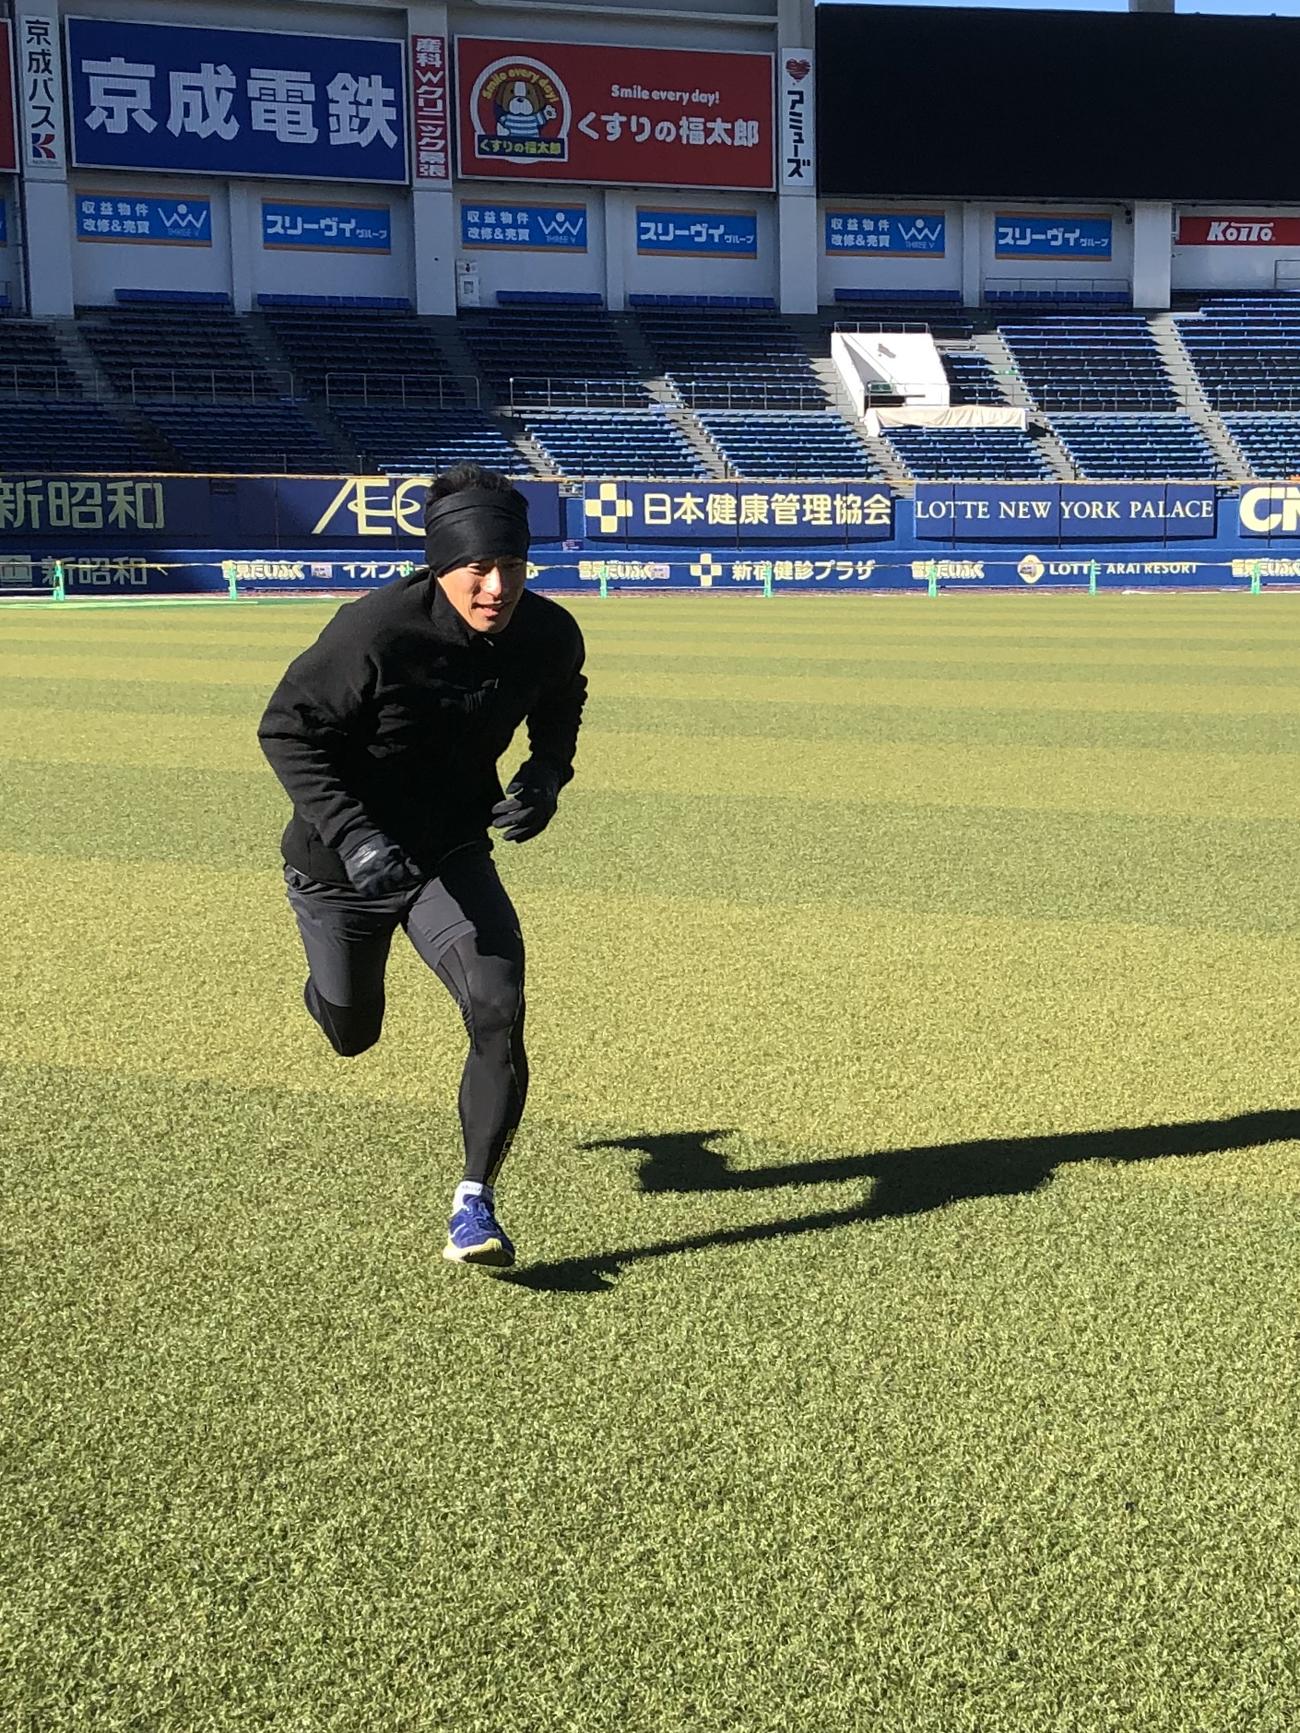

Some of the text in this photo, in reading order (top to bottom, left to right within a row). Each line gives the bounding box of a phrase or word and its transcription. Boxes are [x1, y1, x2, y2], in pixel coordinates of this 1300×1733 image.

[25, 19, 55, 129] 京成バス
[81, 57, 399, 150] 京成電鉄
[611, 84, 720, 107] Smile every day!
[577, 111, 760, 148] くすりの福太郎
[787, 89, 811, 178] アミューズ
[480, 138, 561, 155] くすりの福太郎
[81, 200, 149, 217] 収益物件
[467, 210, 528, 225] 収益物件
[831, 217, 890, 231] 収益物件
[0, 478, 165, 529] 新昭和
[644, 492, 891, 525] 日本健康管理協会
[915, 500, 1214, 519] LOTTE NEW YORK PALACE
[1106, 562, 1140, 574] ARAI
[1144, 562, 1197, 574] RESORT
